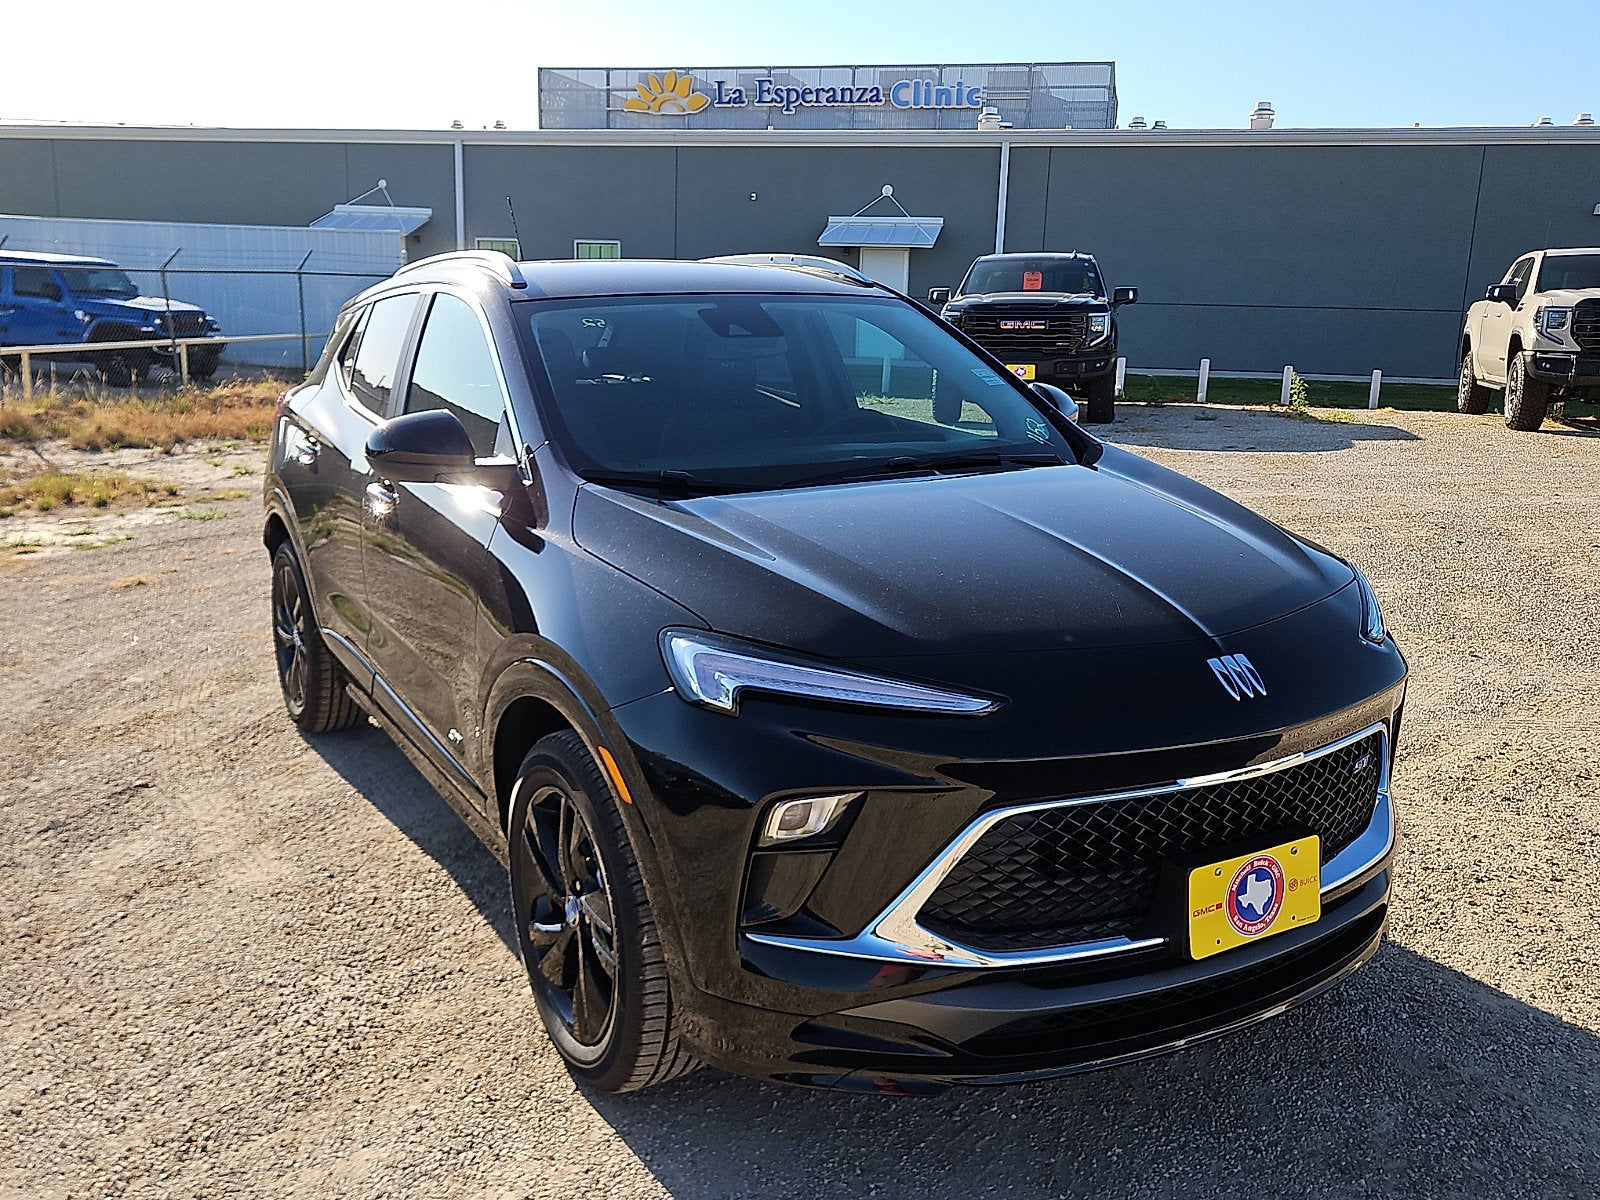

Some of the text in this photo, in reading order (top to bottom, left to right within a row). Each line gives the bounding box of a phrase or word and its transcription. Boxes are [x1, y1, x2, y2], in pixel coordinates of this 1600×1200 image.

[714, 78, 982, 113] La Esperanza Clinic
[1000, 319, 1046, 330] GMC
[1253, 859, 1269, 868] Buick
[1271, 864, 1281, 879] GMC
[1299, 875, 1318, 887] BUICK
[1193, 905, 1216, 918] GMC
[1233, 914, 1243, 929] San
[1265, 902, 1280, 923] Texas
